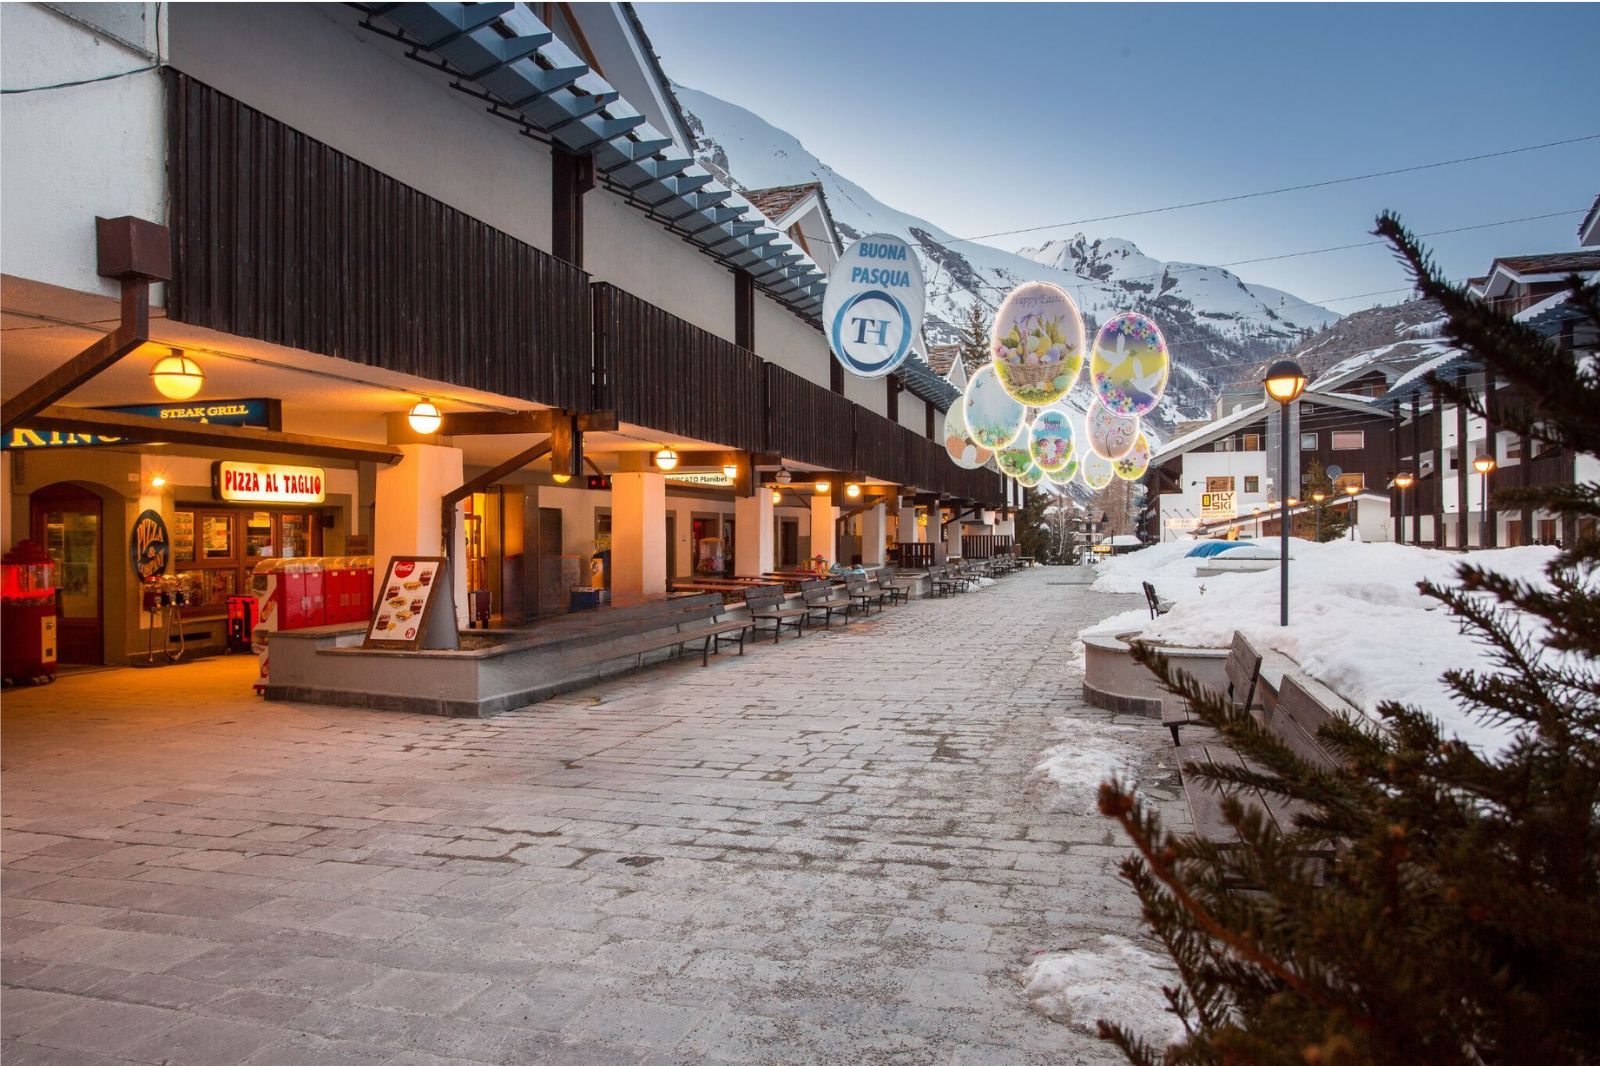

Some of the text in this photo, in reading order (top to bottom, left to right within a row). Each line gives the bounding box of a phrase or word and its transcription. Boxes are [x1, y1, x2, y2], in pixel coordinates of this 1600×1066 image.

[859, 243, 907, 260] BUONA
[852, 266, 910, 288] PASQUA
[851, 317, 891, 347] TH
[160, 405, 249, 419] STEAK GRILL
[225, 470, 321, 495] PIZZA AL TAGLIO
[137, 518, 164, 562] PIZZA
